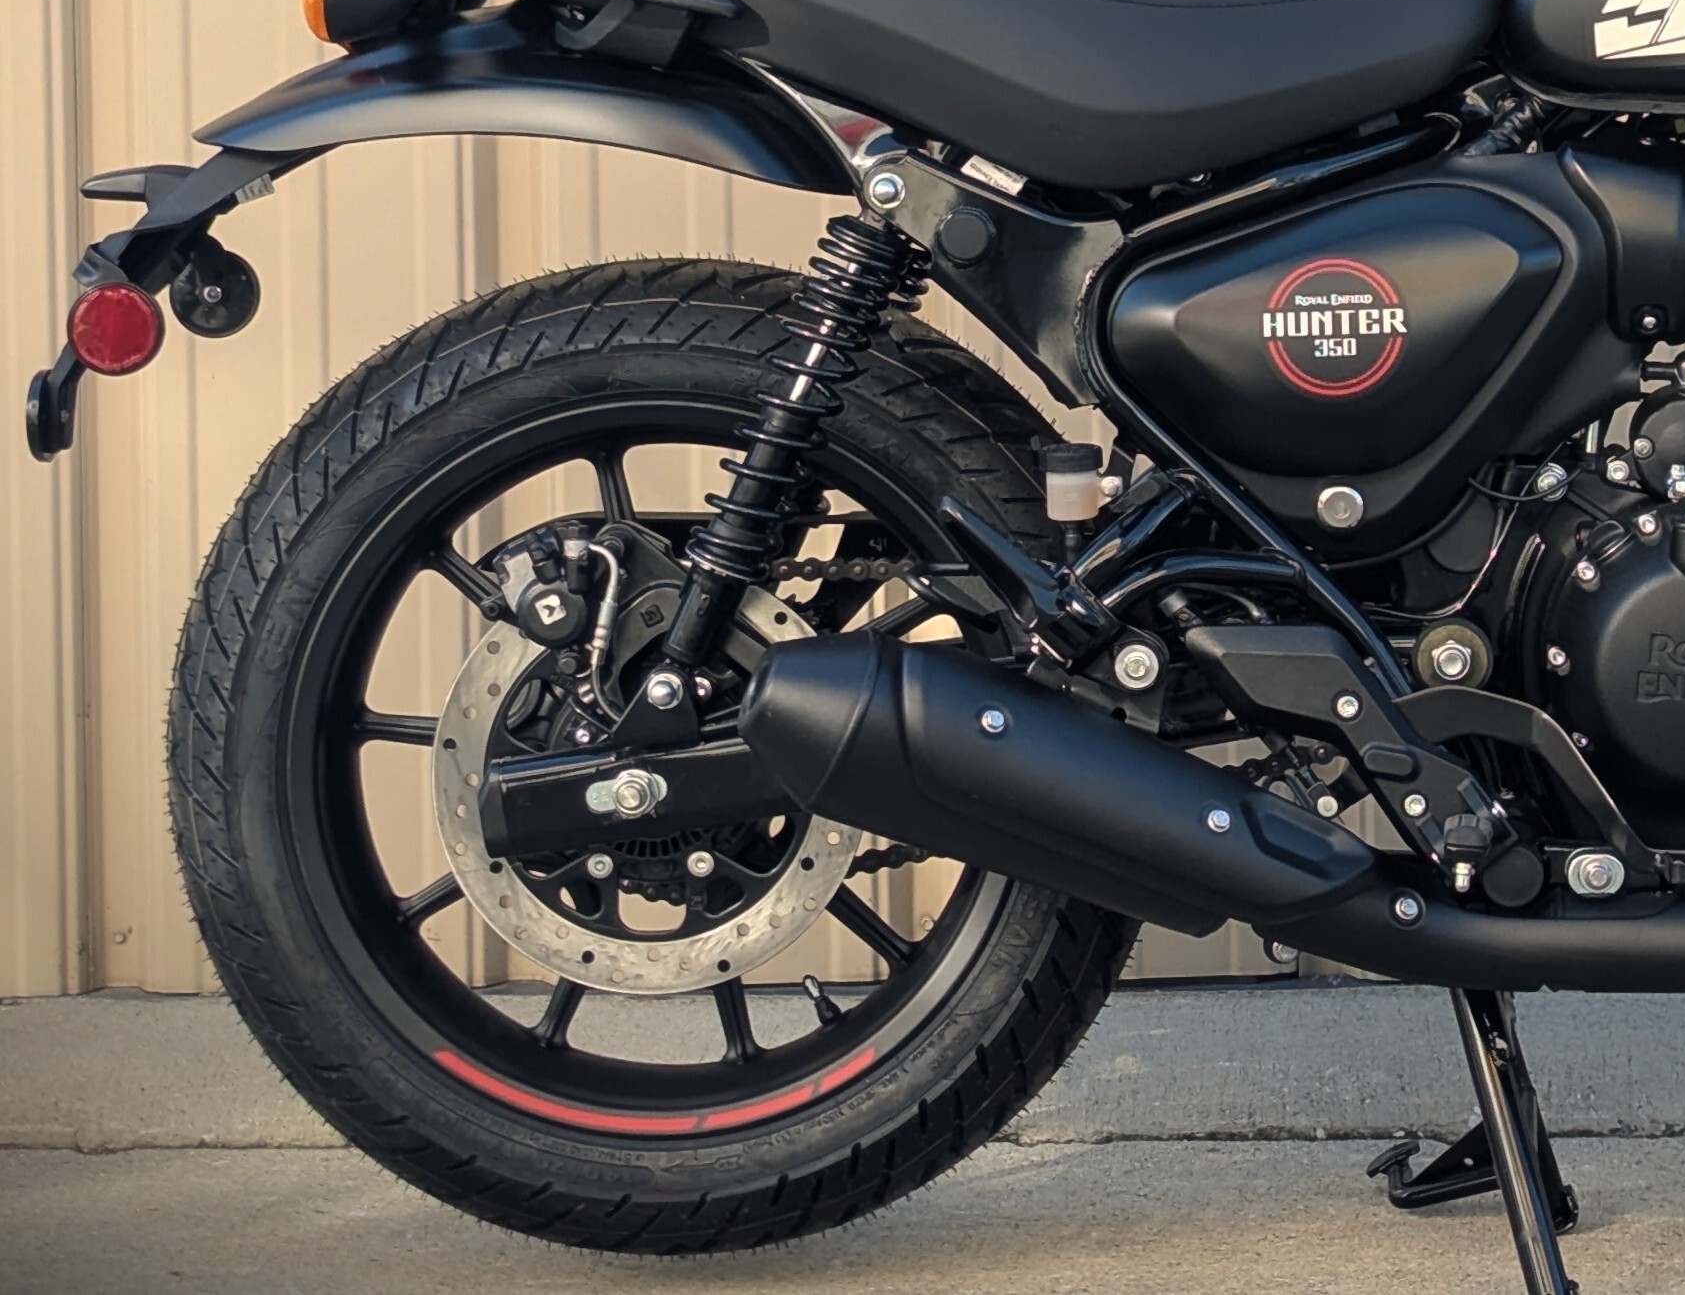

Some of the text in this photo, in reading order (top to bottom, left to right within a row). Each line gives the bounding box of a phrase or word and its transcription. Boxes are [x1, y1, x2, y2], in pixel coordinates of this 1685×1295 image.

[1295, 293, 1373, 306] ROYAL ENFIELD
[1262, 308, 1408, 337] HUNTER
[1314, 338, 1357, 357] 350
